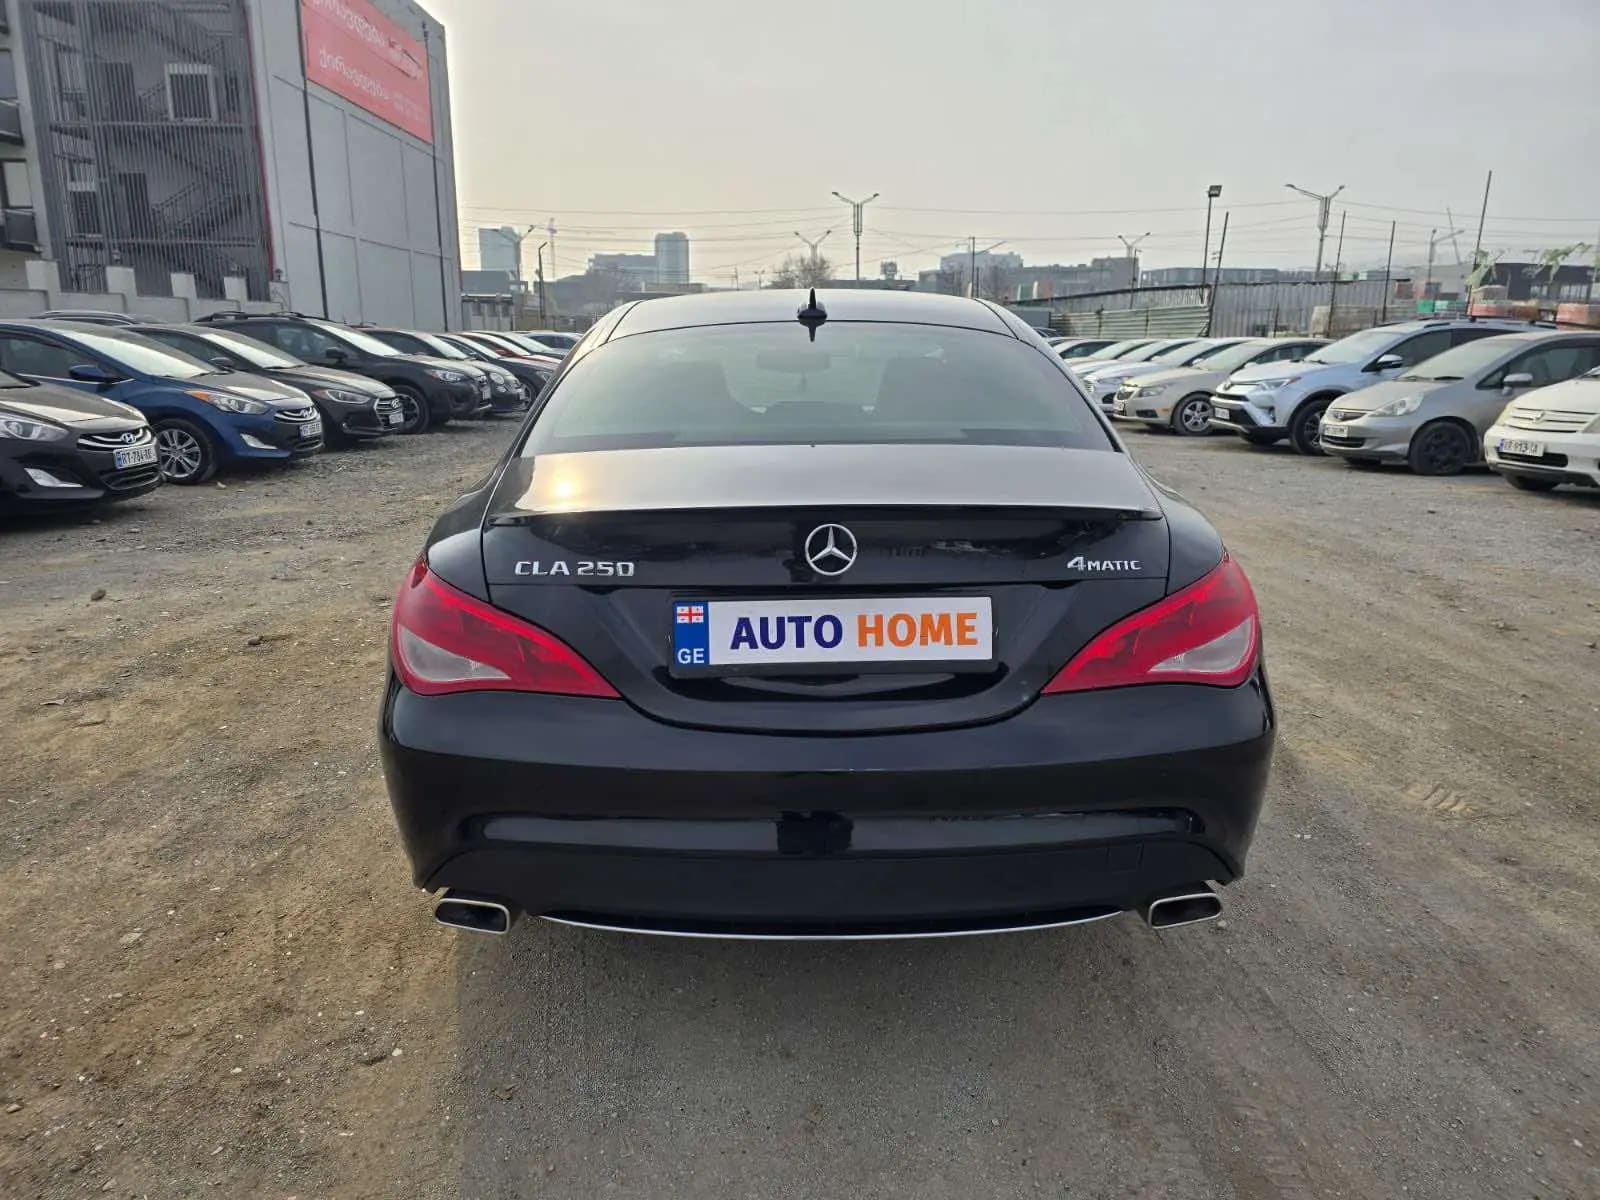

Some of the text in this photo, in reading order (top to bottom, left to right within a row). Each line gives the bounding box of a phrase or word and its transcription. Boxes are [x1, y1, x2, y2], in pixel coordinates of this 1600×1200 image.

[514, 560, 635, 577] CLA 250
[1066, 556, 1142, 571] 4MATIC
[730, 612, 978, 650] AUTO HOME
[677, 648, 705, 664] GE
